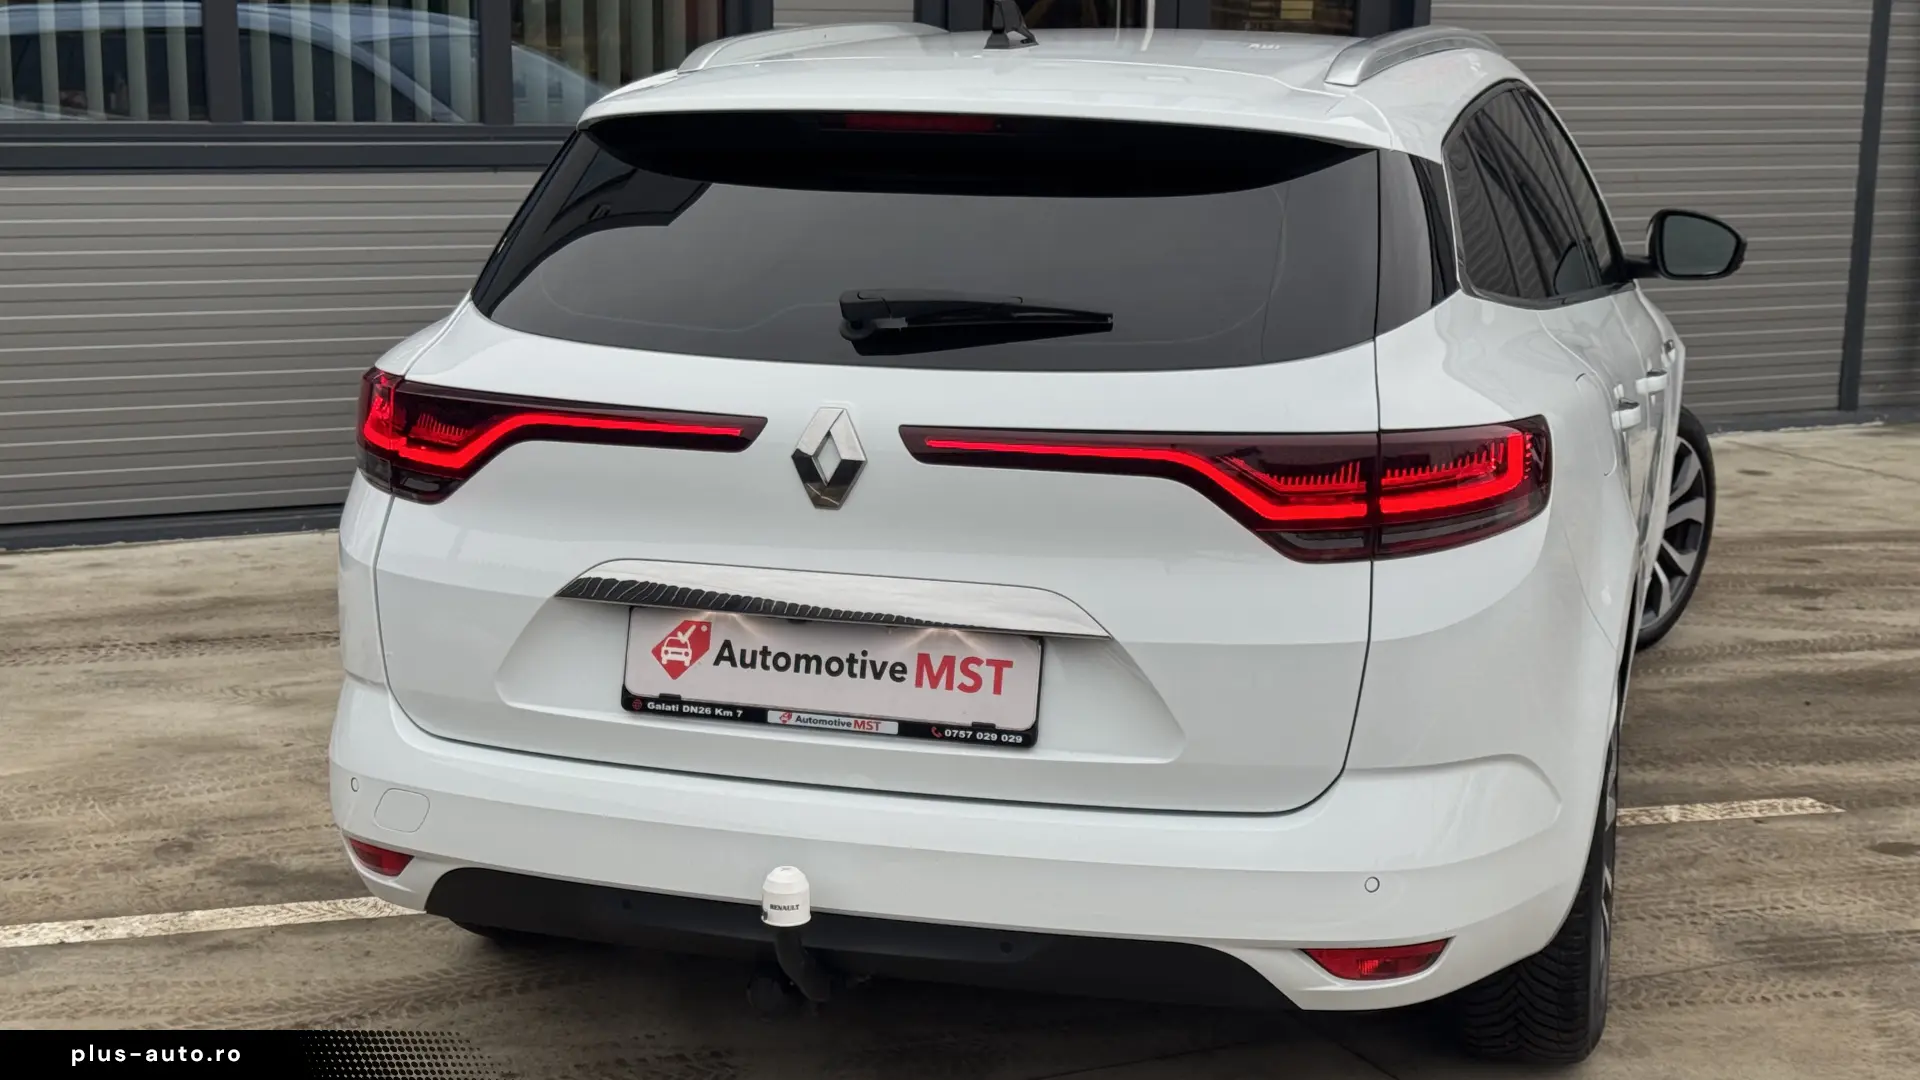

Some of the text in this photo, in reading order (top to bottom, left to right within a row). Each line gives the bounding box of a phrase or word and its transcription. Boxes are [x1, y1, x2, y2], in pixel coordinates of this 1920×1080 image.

[713, 639, 1014, 696] Automotive MST
[647, 701, 744, 718] Galati DN26 Km 7
[795, 715, 882, 732] Automotive MST
[944, 729, 1023, 744] 0757 029 029
[769, 903, 800, 911] RENAULT
